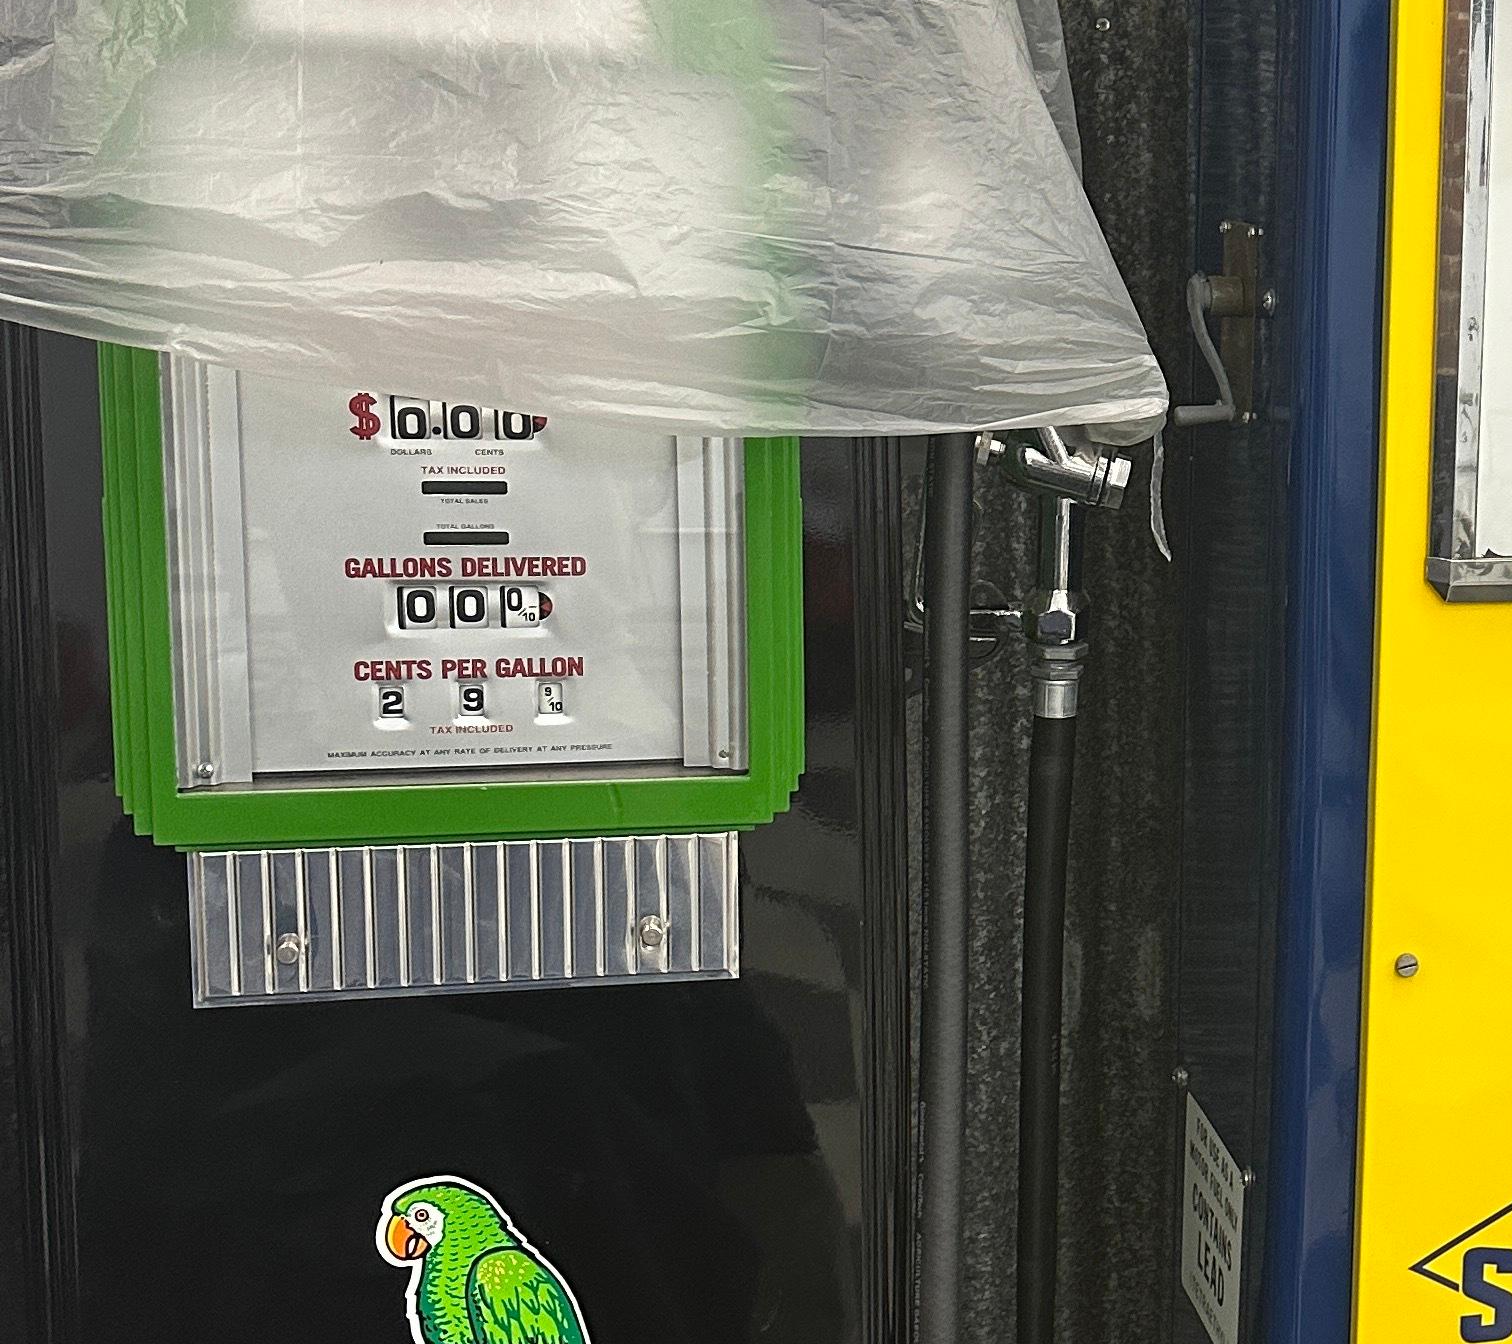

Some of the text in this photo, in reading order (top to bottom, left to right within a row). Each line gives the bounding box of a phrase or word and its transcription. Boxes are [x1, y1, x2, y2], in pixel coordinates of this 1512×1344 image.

[421, 466, 506, 475] TAX INCLUDED
[344, 556, 587, 578] GALLONS DELIVERED
[354, 657, 584, 681] CENTS PER GALLON
[382, 691, 403, 715] 2
[463, 688, 485, 712] 9
[430, 725, 514, 734] TAX INCLUDED
[1193, 1182, 1232, 1271] CONTAINS
[1198, 1229, 1225, 1308] LEAD
